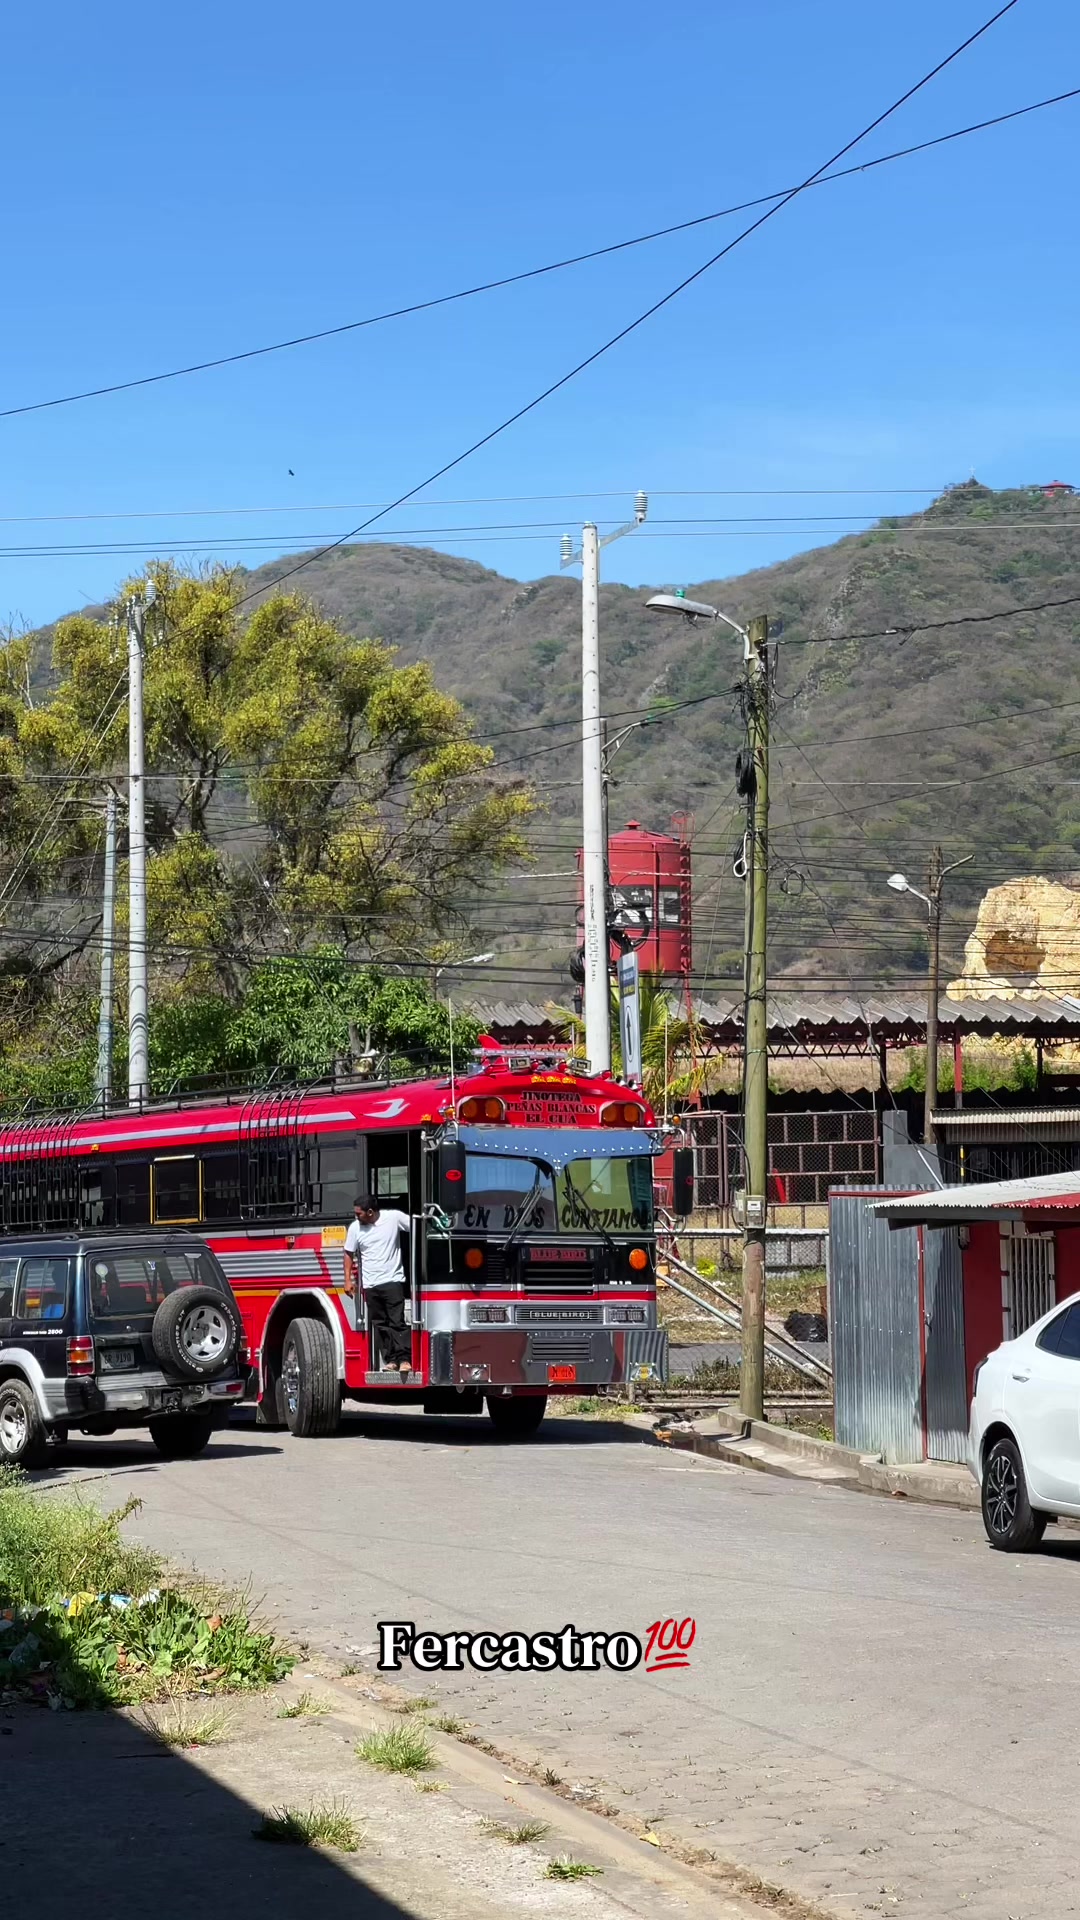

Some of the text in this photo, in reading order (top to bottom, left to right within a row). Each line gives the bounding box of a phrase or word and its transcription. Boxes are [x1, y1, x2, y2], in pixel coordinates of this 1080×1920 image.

[521, 1091, 581, 1102] JINOTEGA
[506, 1102, 597, 1114] PEÑAS BLANCAS
[525, 1113, 544, 1123] EL
[464, 1205, 491, 1228] EN
[503, 1205, 545, 1229] DIOS
